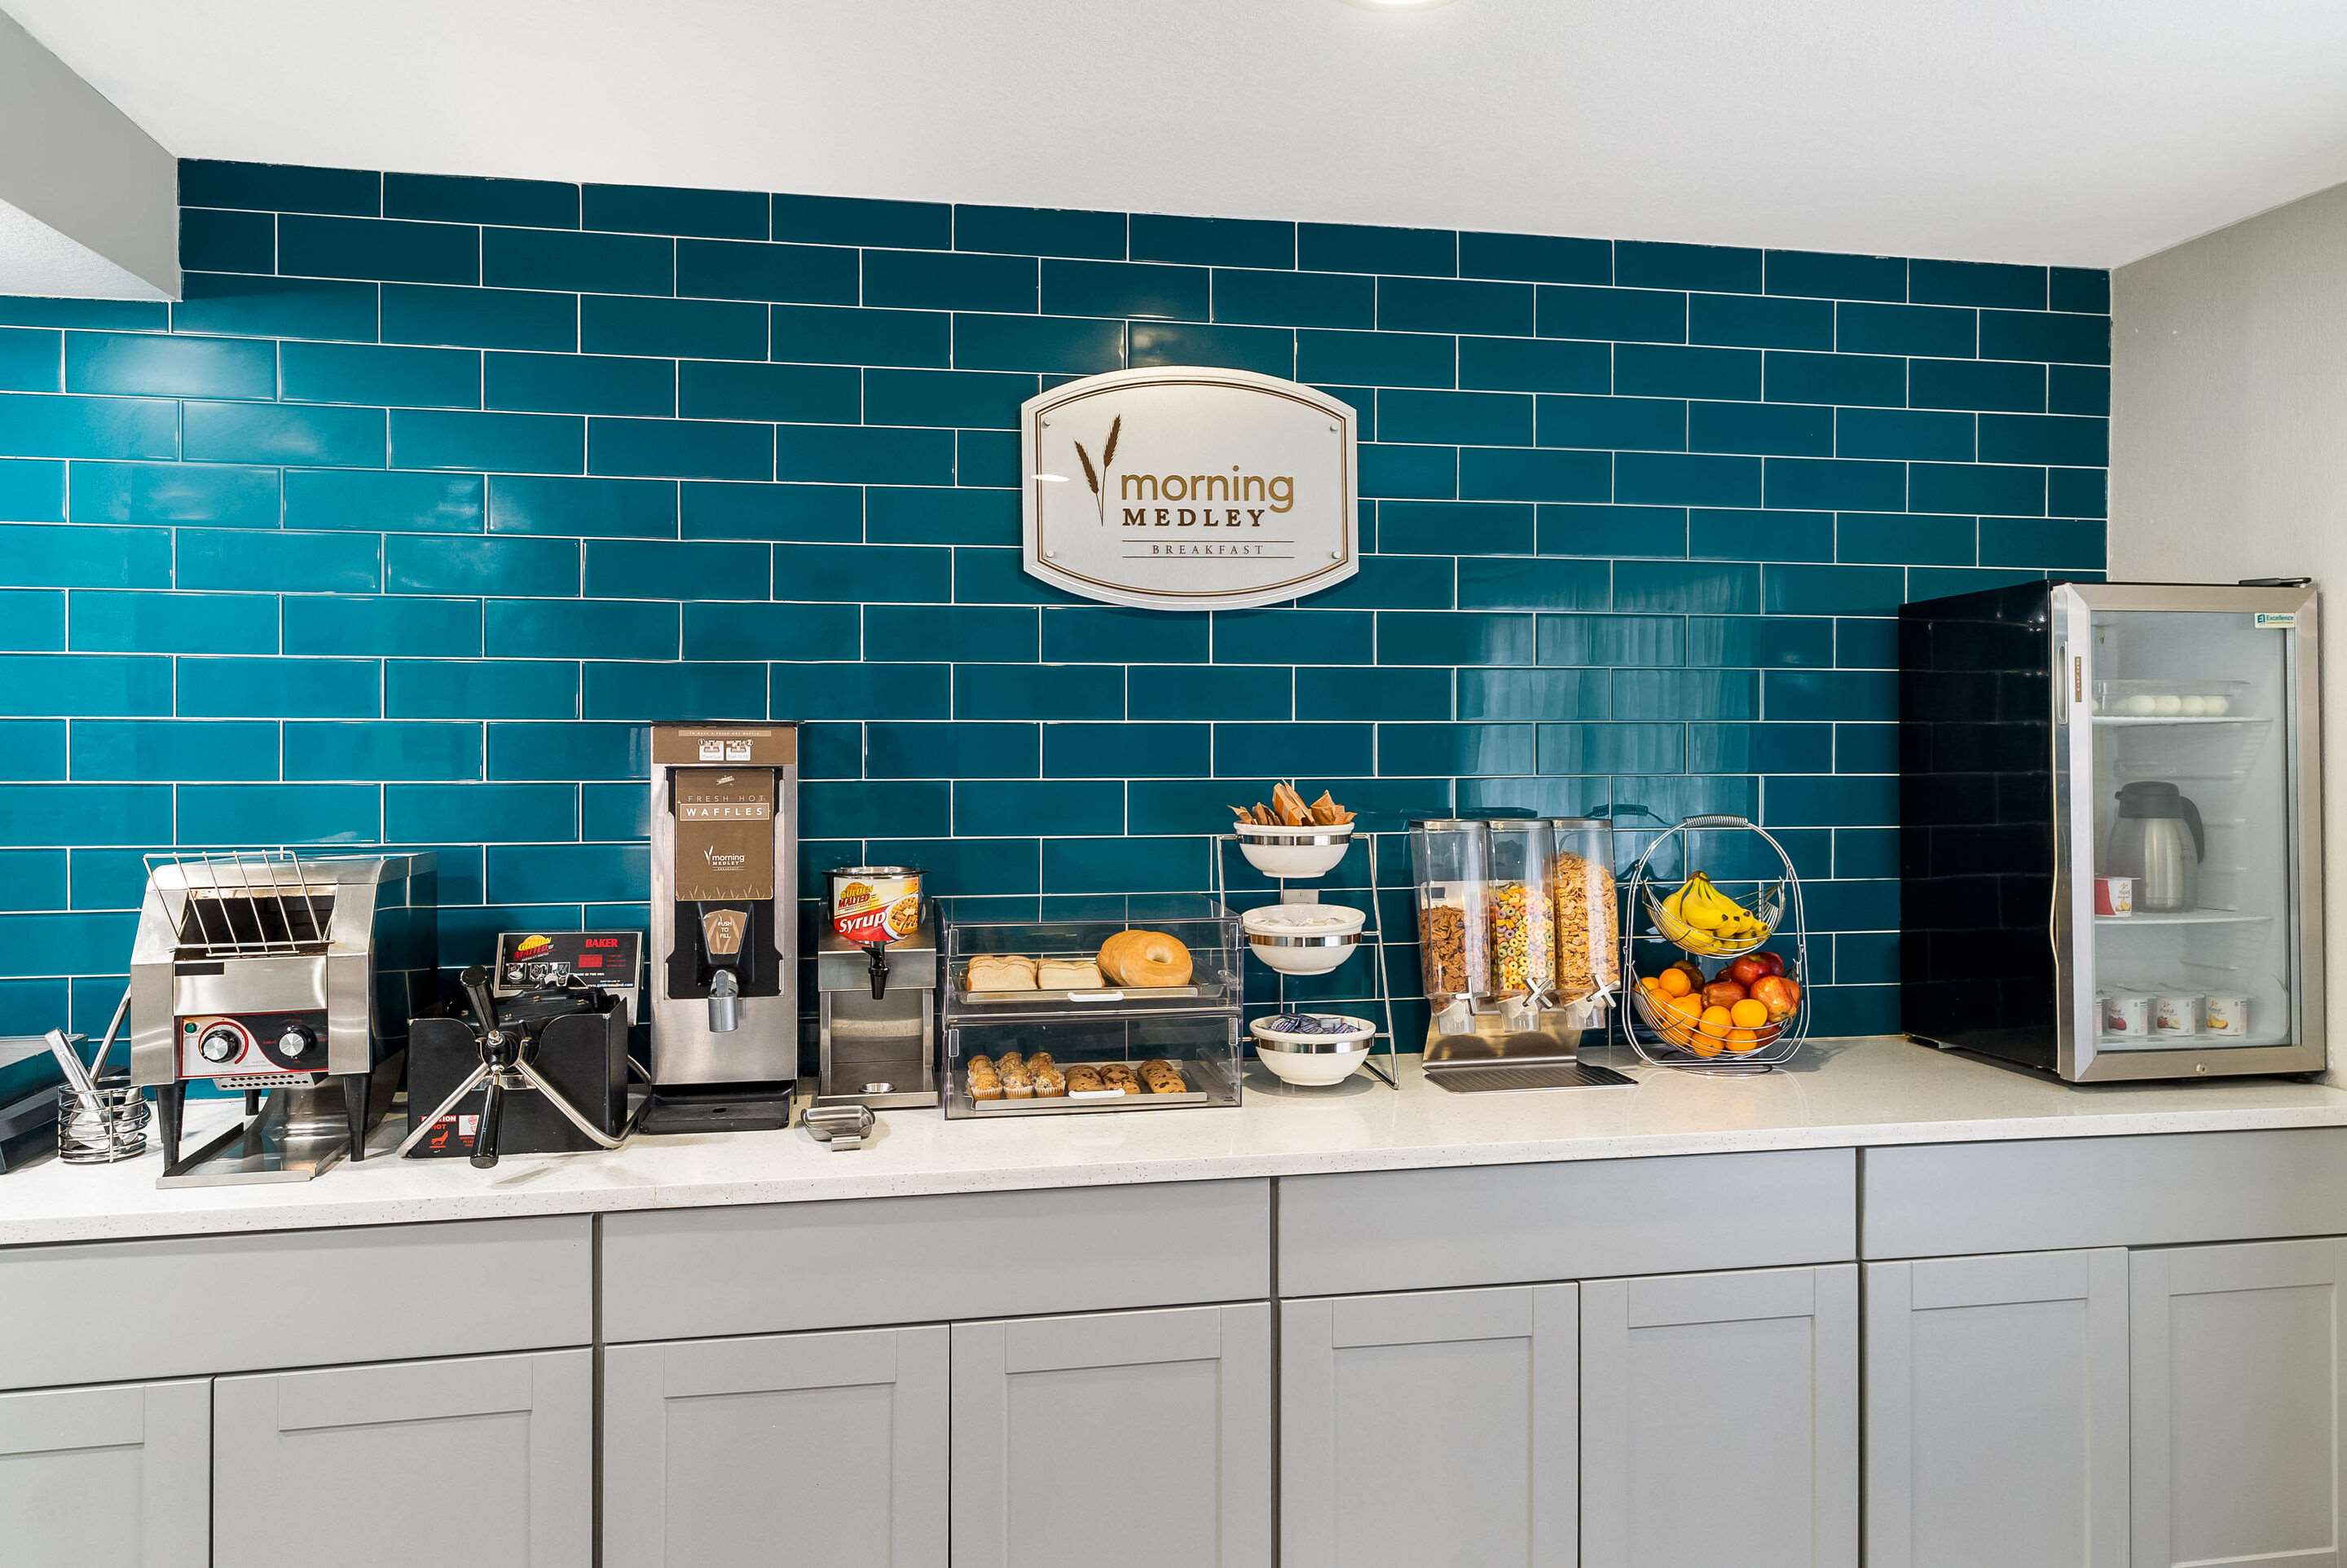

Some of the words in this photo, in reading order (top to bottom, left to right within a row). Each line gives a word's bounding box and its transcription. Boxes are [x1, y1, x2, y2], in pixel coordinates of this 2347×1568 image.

[1121, 465, 1295, 513] morning
[1121, 508, 1266, 527] MEDLEY
[1151, 544, 1265, 555] BREAKFAST
[738, 795, 764, 803] HOT
[685, 807, 763, 817] WAFFLES
[711, 853, 745, 863] morning
[839, 911, 887, 933] Syrup
[585, 938, 619, 948] BAKER
